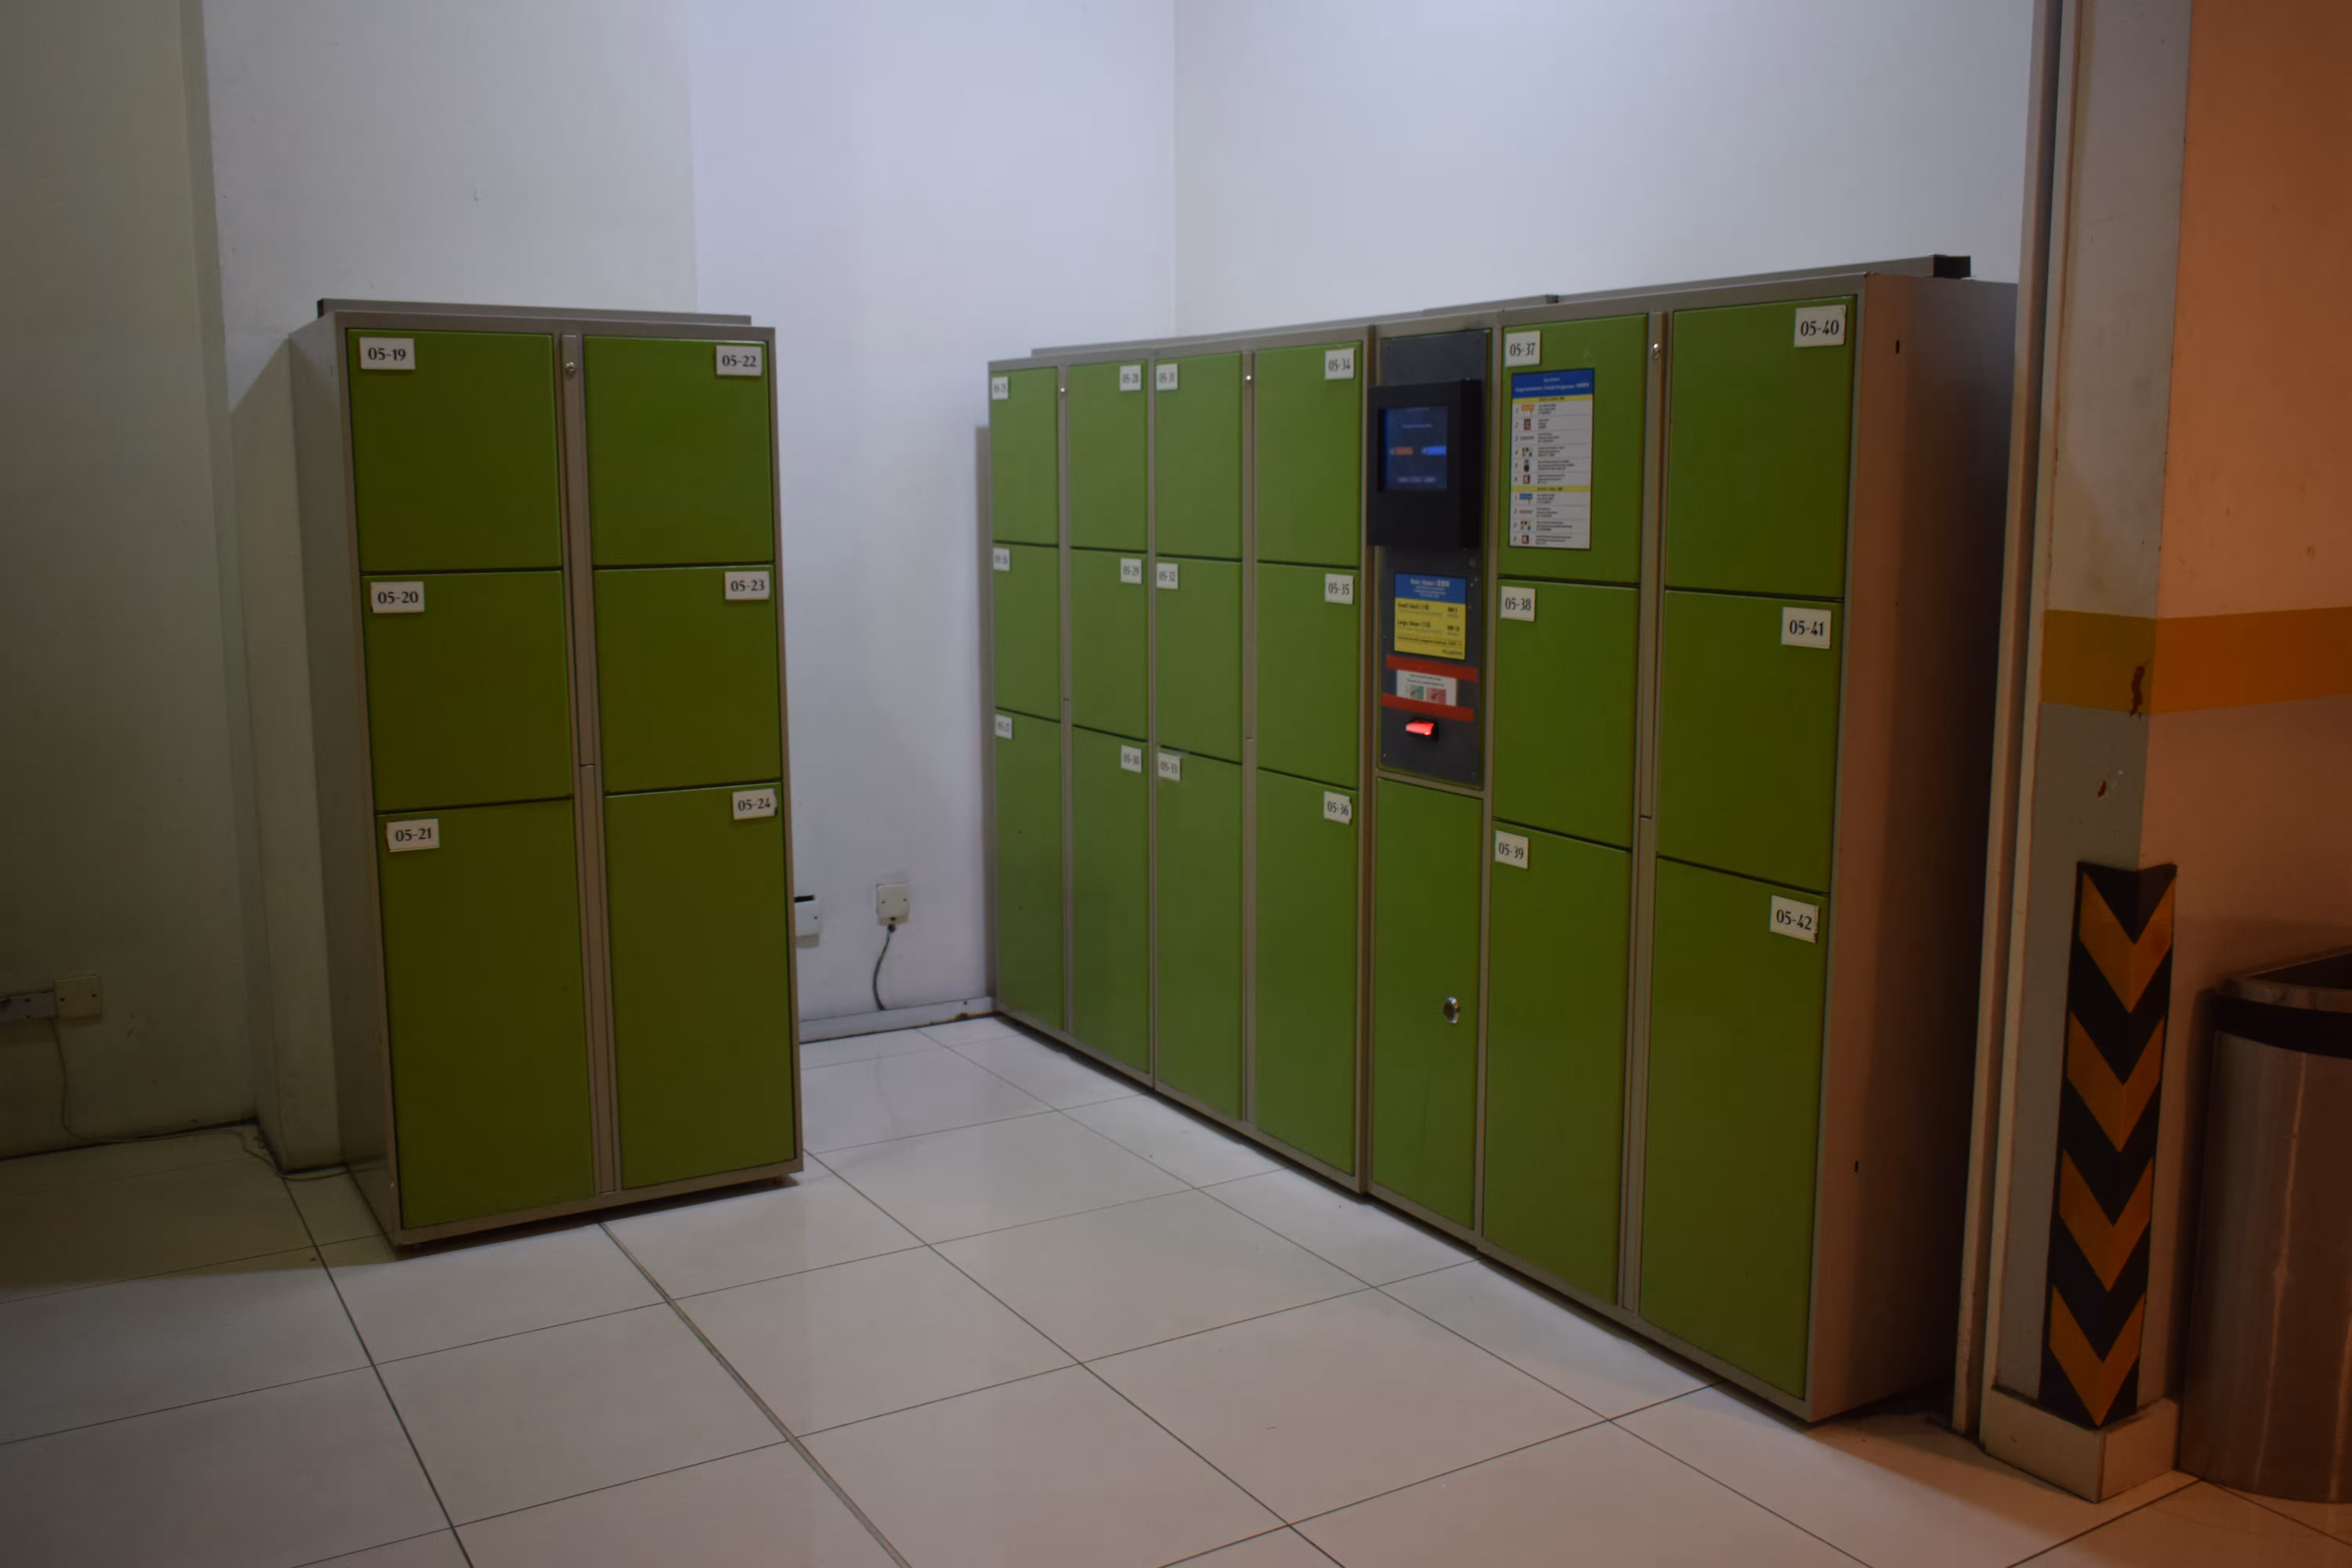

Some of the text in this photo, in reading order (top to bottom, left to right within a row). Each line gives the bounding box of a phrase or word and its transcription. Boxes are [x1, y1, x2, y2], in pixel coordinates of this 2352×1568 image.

[1801, 320, 1838, 336] 05-40
[368, 347, 406, 361] 05-19
[1510, 342, 1535, 356] 05-37
[722, 354, 756, 367] 05-22
[1328, 358, 1350, 372] 05-34
[1123, 565, 1140, 577] 05-29
[1159, 570, 1175, 583] 05-32
[731, 580, 764, 592] 05-23
[1328, 583, 1350, 595] 05-35
[377, 591, 418, 604] 05-20
[1505, 597, 1531, 610] 05-38
[1789, 620, 1824, 636] 05-41
[1123, 752, 1140, 766] 05-30
[1161, 761, 1178, 773] 05-33
[738, 798, 770, 811] 05-24
[1327, 802, 1348, 815] 05-36
[396, 828, 432, 841] 05-21
[1499, 841, 1523, 859] 05-39
[1777, 908, 1811, 930] 05-42
